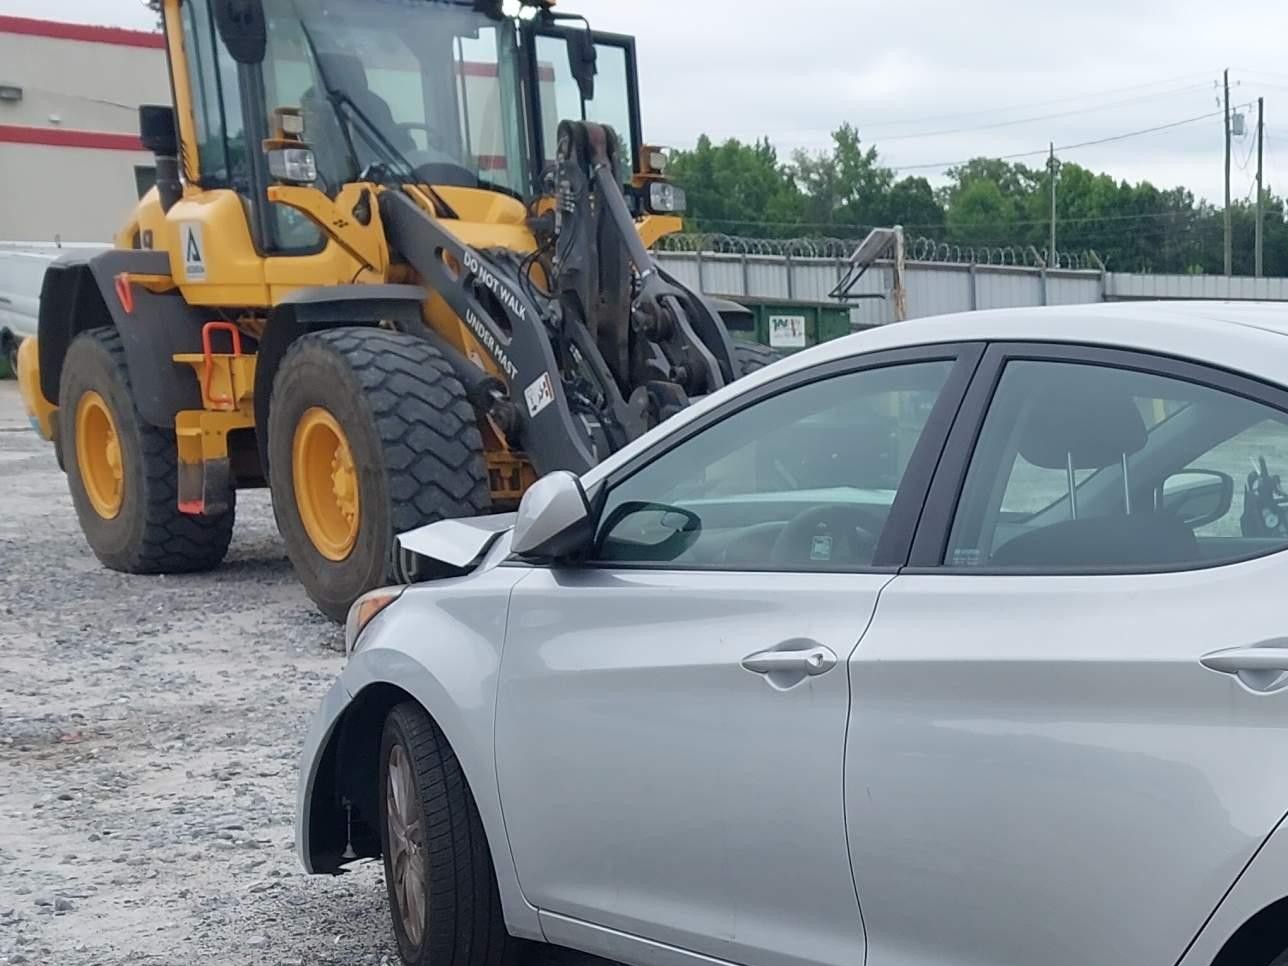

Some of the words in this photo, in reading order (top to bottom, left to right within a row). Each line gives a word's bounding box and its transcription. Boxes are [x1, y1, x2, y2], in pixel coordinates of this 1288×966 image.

[463, 251, 478, 273] DO
[479, 266, 500, 293] NOT
[500, 285, 526, 321] WALK
[465, 308, 495, 351] UNDER
[494, 344, 519, 380] MAST
